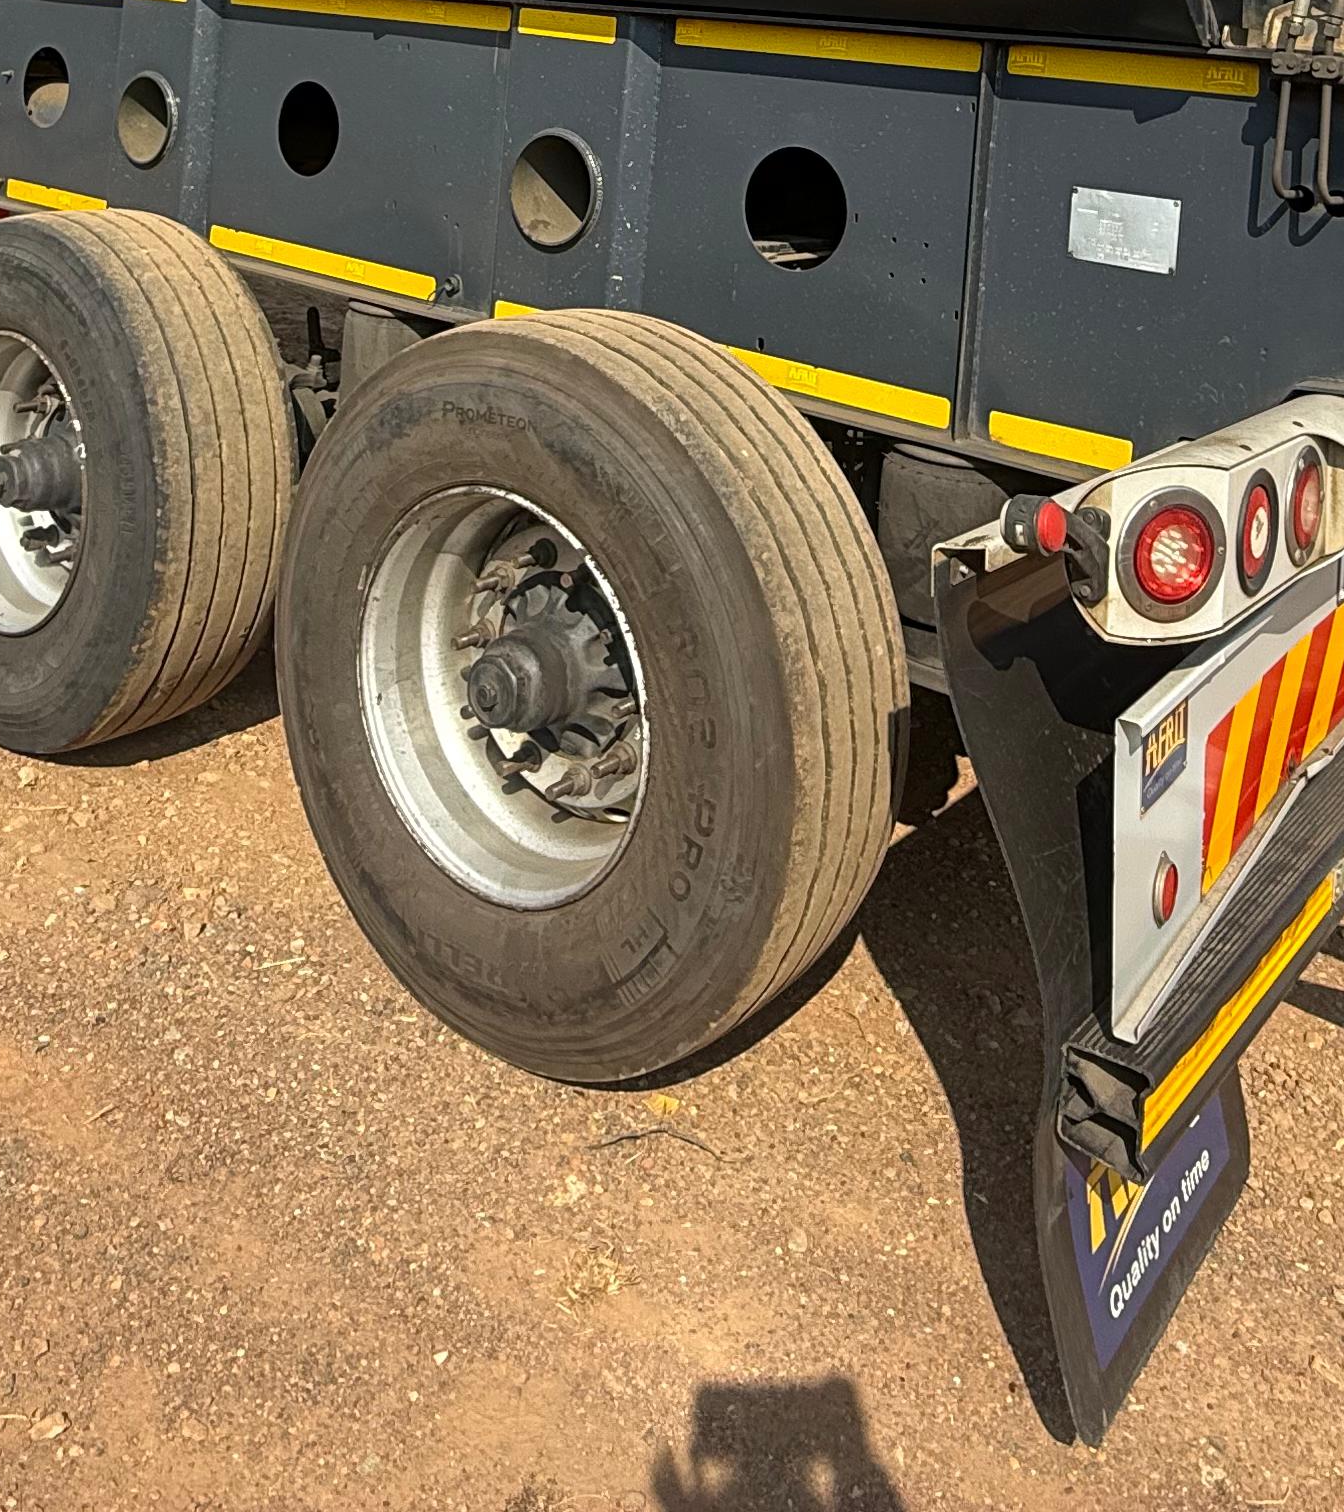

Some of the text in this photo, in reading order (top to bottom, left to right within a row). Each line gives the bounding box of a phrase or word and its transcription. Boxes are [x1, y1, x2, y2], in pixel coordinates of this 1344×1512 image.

[1205, 66, 1245, 82] AFRIT
[1145, 702, 1187, 777] AFRIT
[1110, 1225, 1160, 1319] Quality
[1162, 1196, 1181, 1233] on
[1181, 1149, 1210, 1202] time
